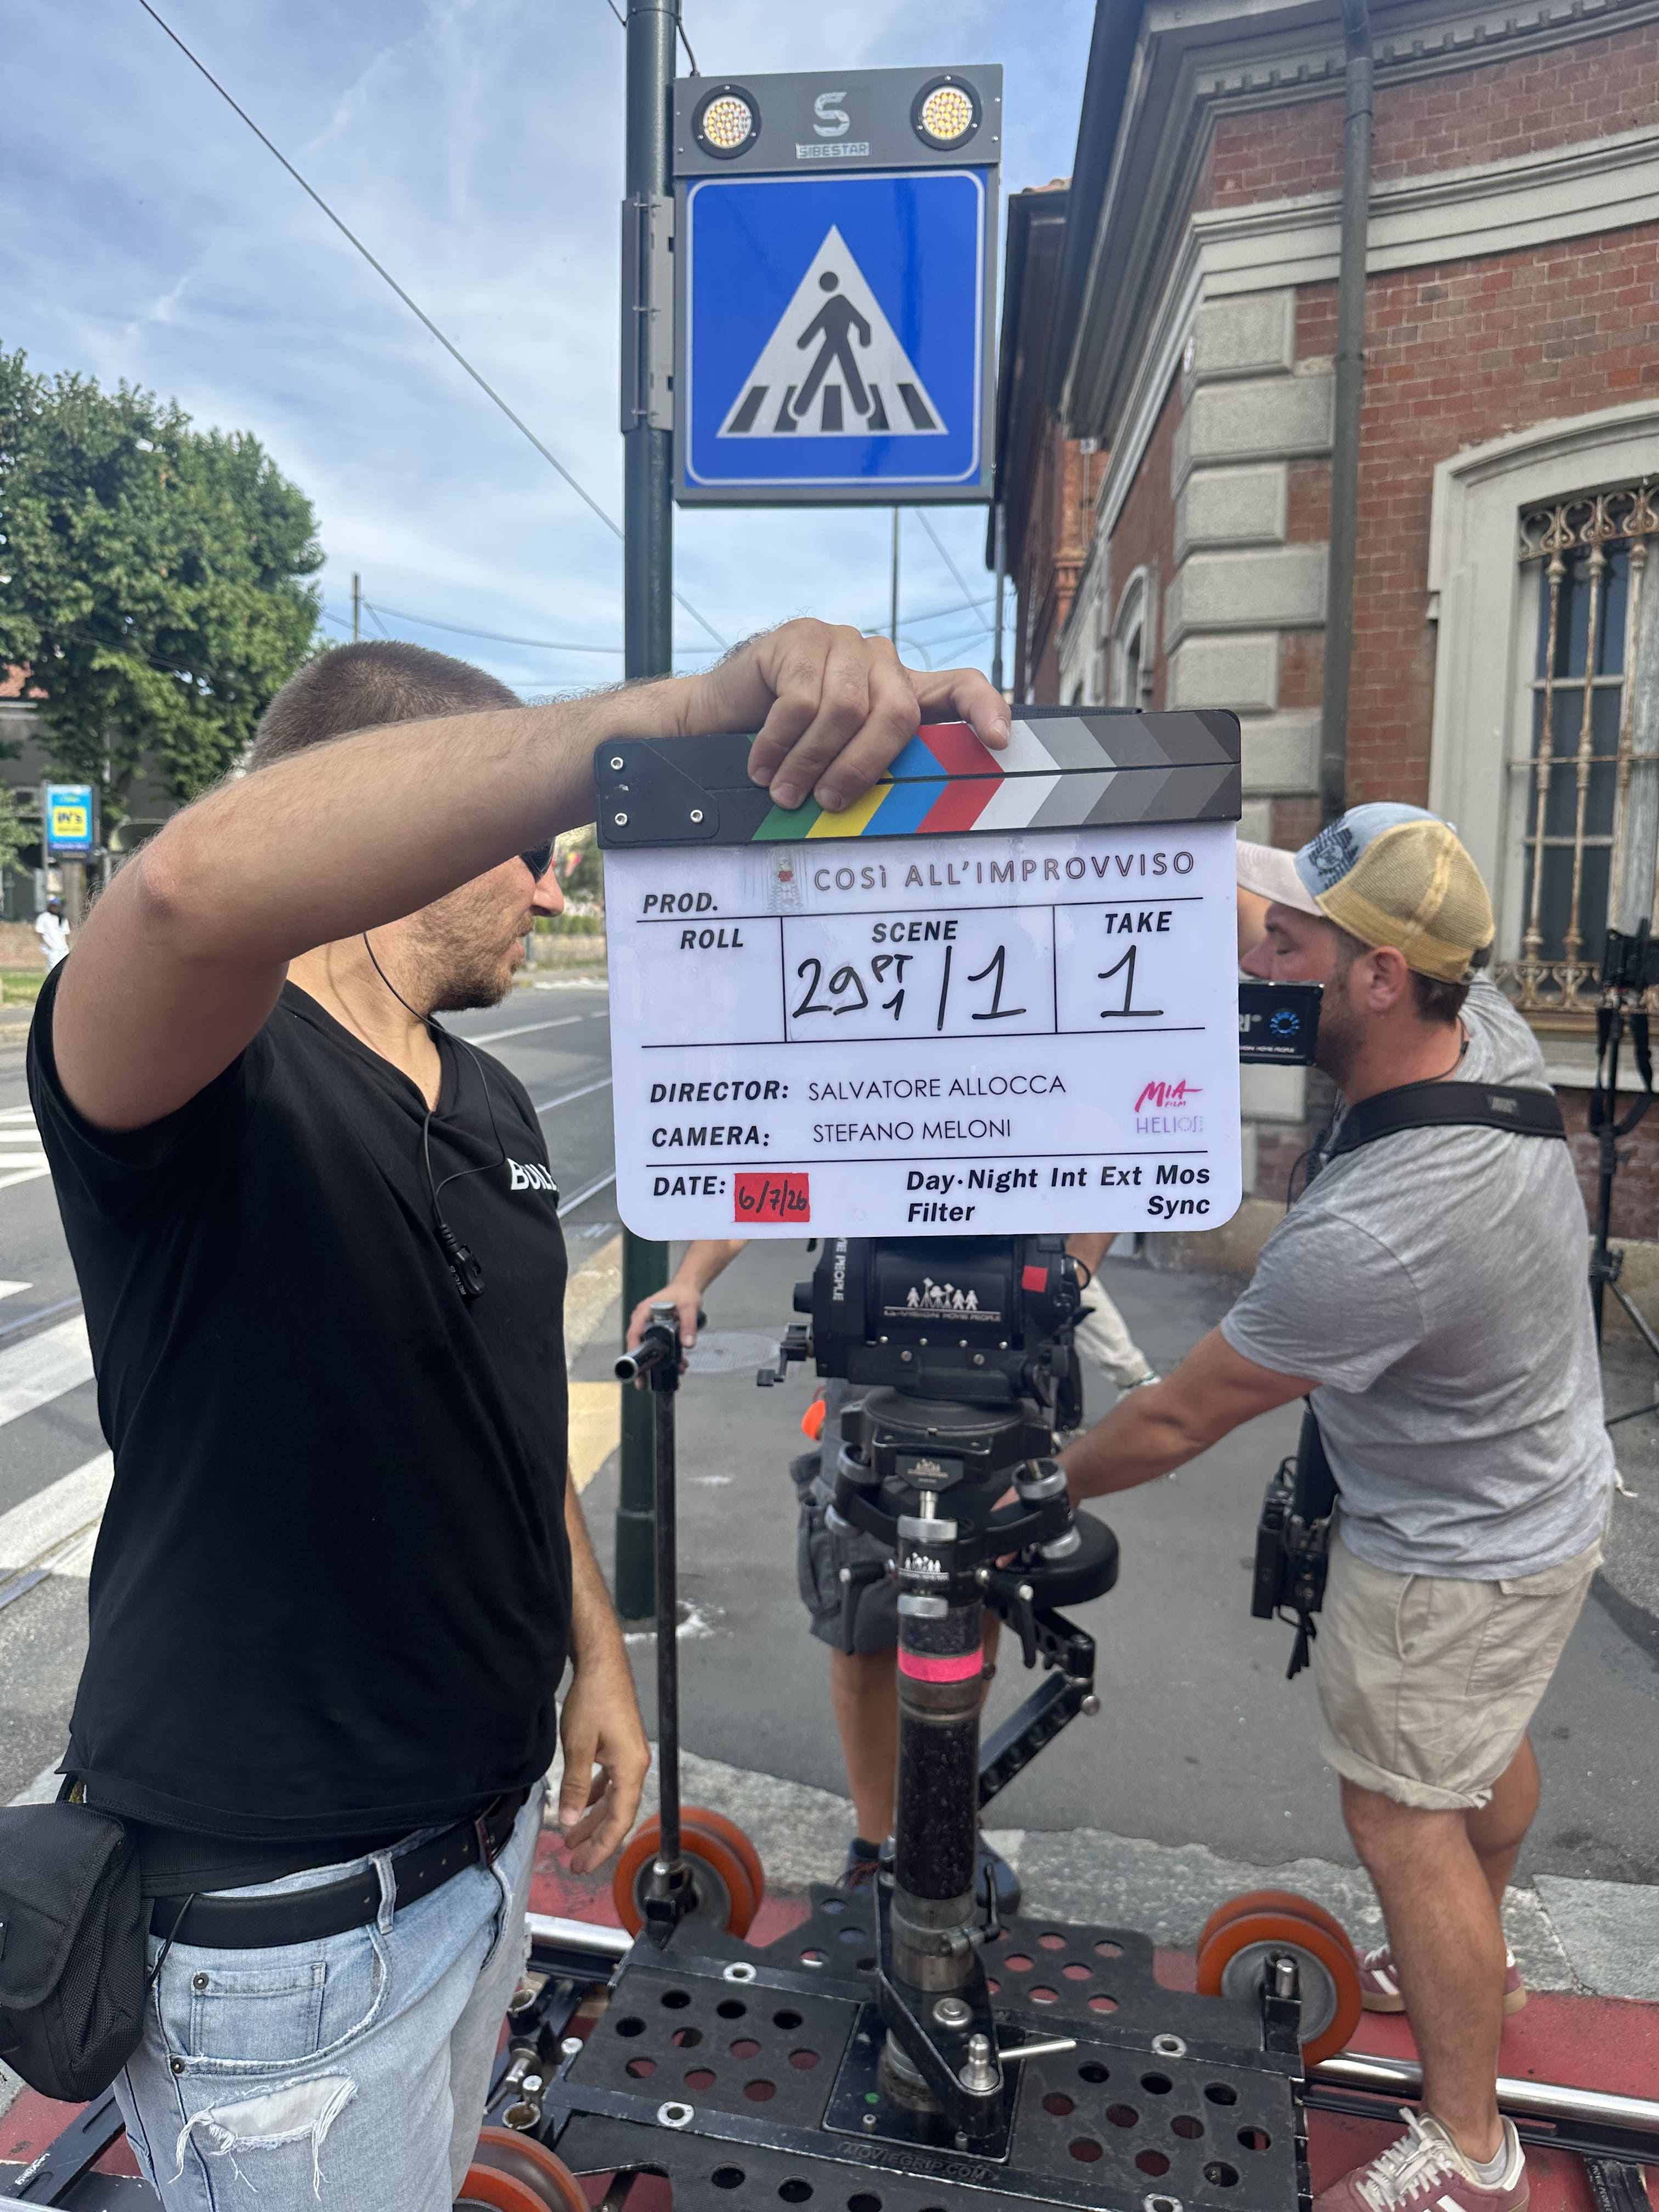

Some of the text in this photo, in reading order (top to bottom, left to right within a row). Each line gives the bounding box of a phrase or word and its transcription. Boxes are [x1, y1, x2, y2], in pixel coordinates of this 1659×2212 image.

[798, 144, 867, 158] SIBESTAR
[643, 892, 718, 913] PROD.
[872, 920, 958, 944] SCENE
[1104, 911, 1172, 934] TAKE
[680, 928, 744, 949] ROLL
[792, 958, 868, 1018] 29
[967, 945, 1026, 1020] 1
[1098, 944, 1164, 1018] 1
[650, 1080, 789, 1103] DIRECTOR:
[808, 1074, 1066, 1102] SALVATORE ALLOCCA
[1135, 1079, 1204, 1113] MIA
[652, 1125, 770, 1147] CAMERA:
[812, 1119, 1011, 1143] STEFANO MELONI
[653, 1176, 726, 1197] DATE:
[1051, 1167, 1088, 1187] Int
[1100, 1166, 1143, 1186] Ext
[1155, 1164, 1211, 1185] Mos
[738, 1179, 808, 1217] 6/7/26
[1147, 1195, 1211, 1220] Sync
[907, 1202, 975, 1223] Filter
[833, 1255, 846, 1301] PEOPLE
[843, 2141, 987, 2181] MOVIEGRIP.COM
